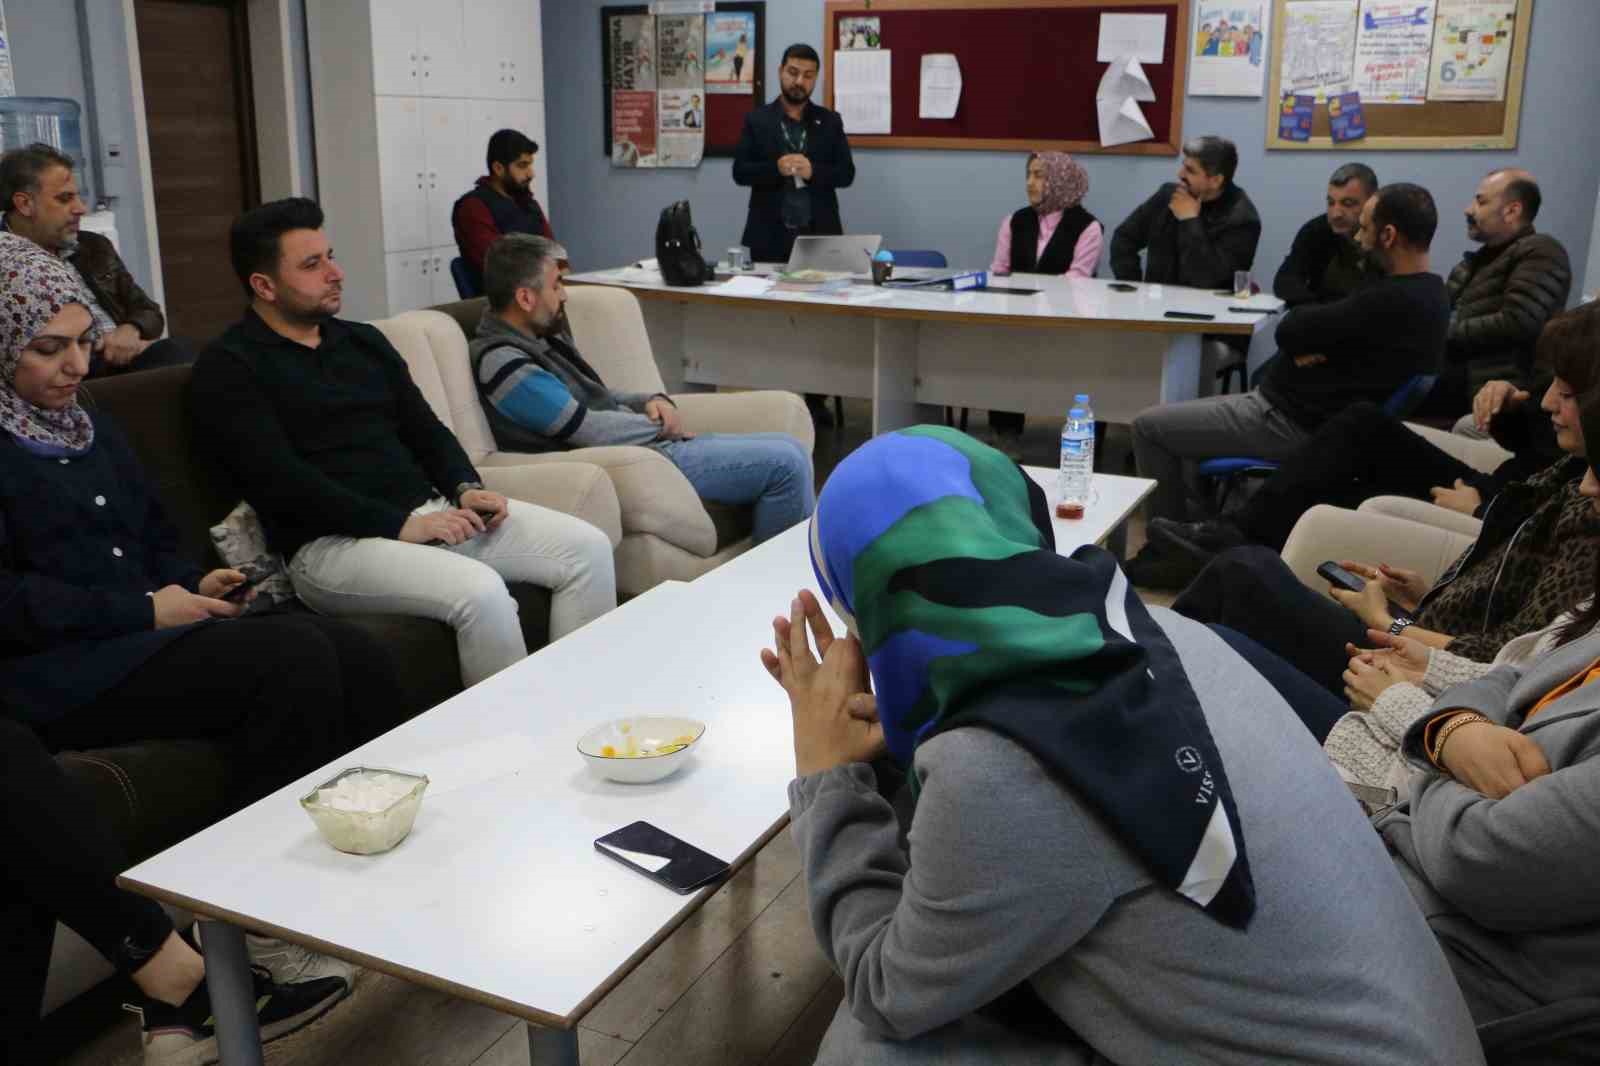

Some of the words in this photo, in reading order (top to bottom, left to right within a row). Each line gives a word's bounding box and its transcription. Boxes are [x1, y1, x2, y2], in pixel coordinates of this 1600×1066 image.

[624, 40, 634, 90] HAYIR
[1440, 61, 1456, 82] 6
[1183, 751, 1196, 763] V
